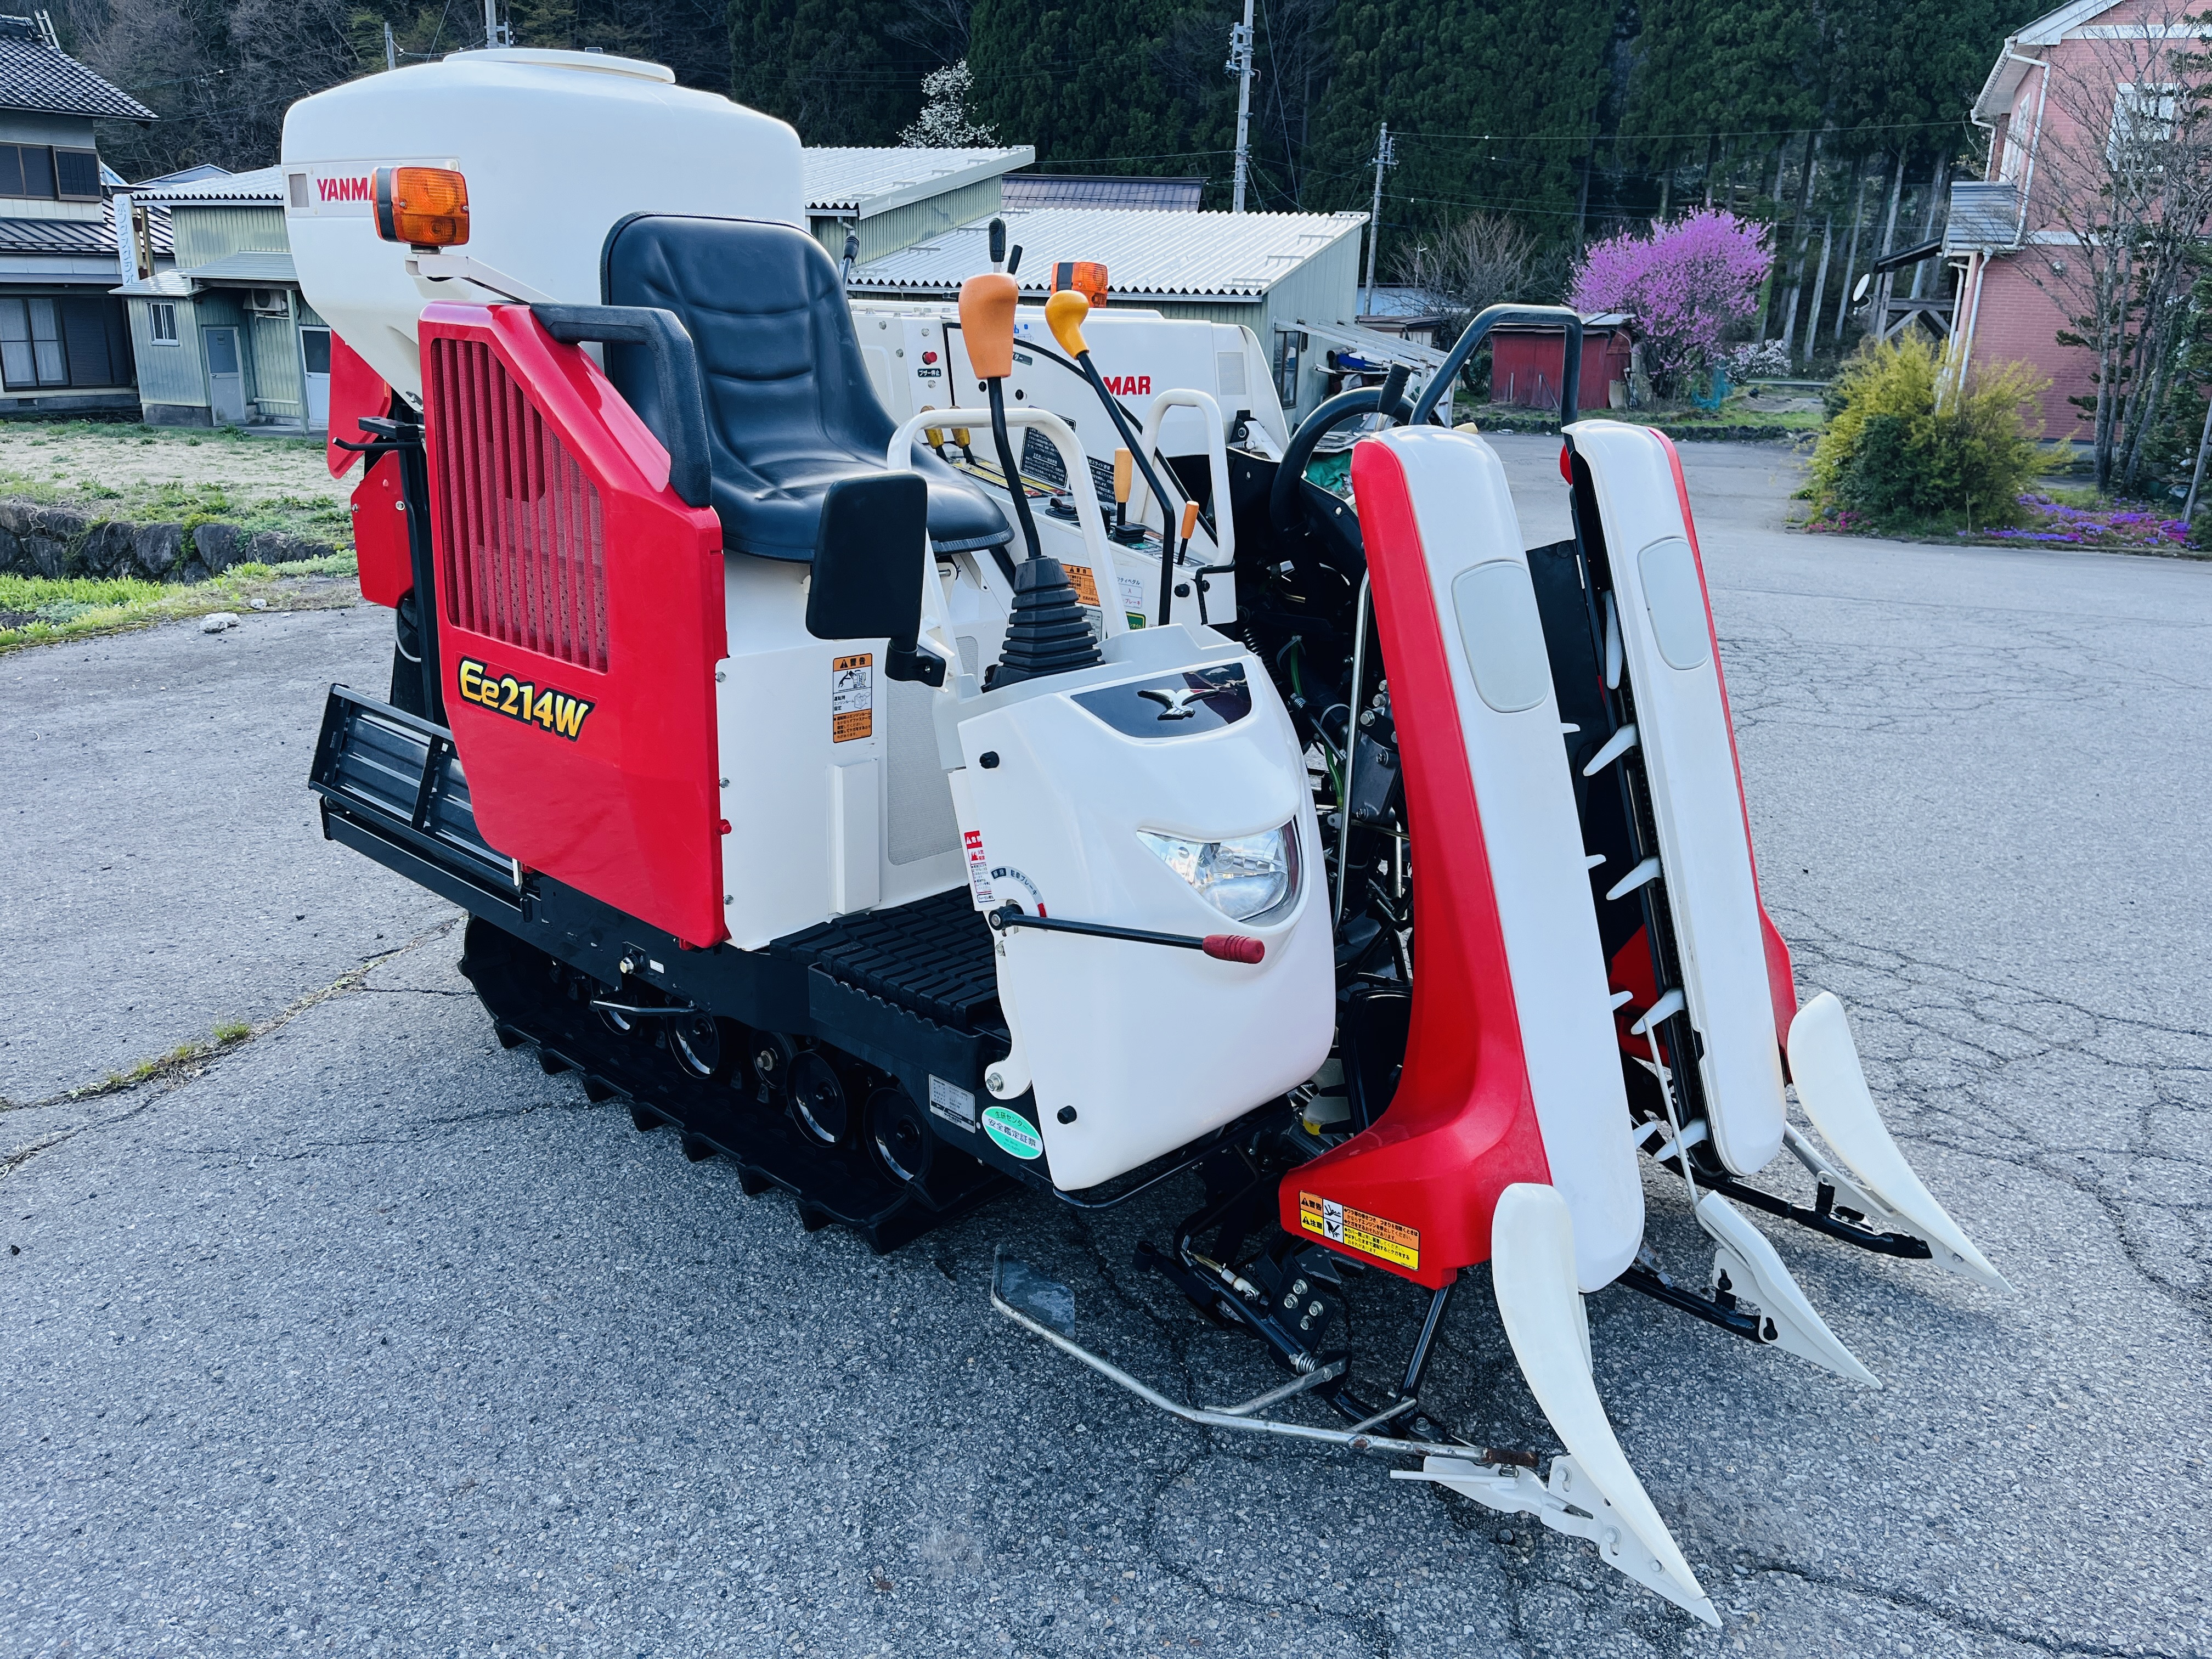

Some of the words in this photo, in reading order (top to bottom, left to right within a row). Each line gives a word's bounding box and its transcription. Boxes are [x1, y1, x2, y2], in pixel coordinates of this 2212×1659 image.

[317, 177, 373, 201] YANM
[850, 657, 866, 667] 警告
[459, 659, 590, 738] Ee214W
[995, 1111, 1028, 1130] 生研センター
[988, 1118, 1036, 1148] 安全鑑定証票
[1309, 1200, 1322, 1211] 警告
[1310, 1218, 1323, 1230] 注意
